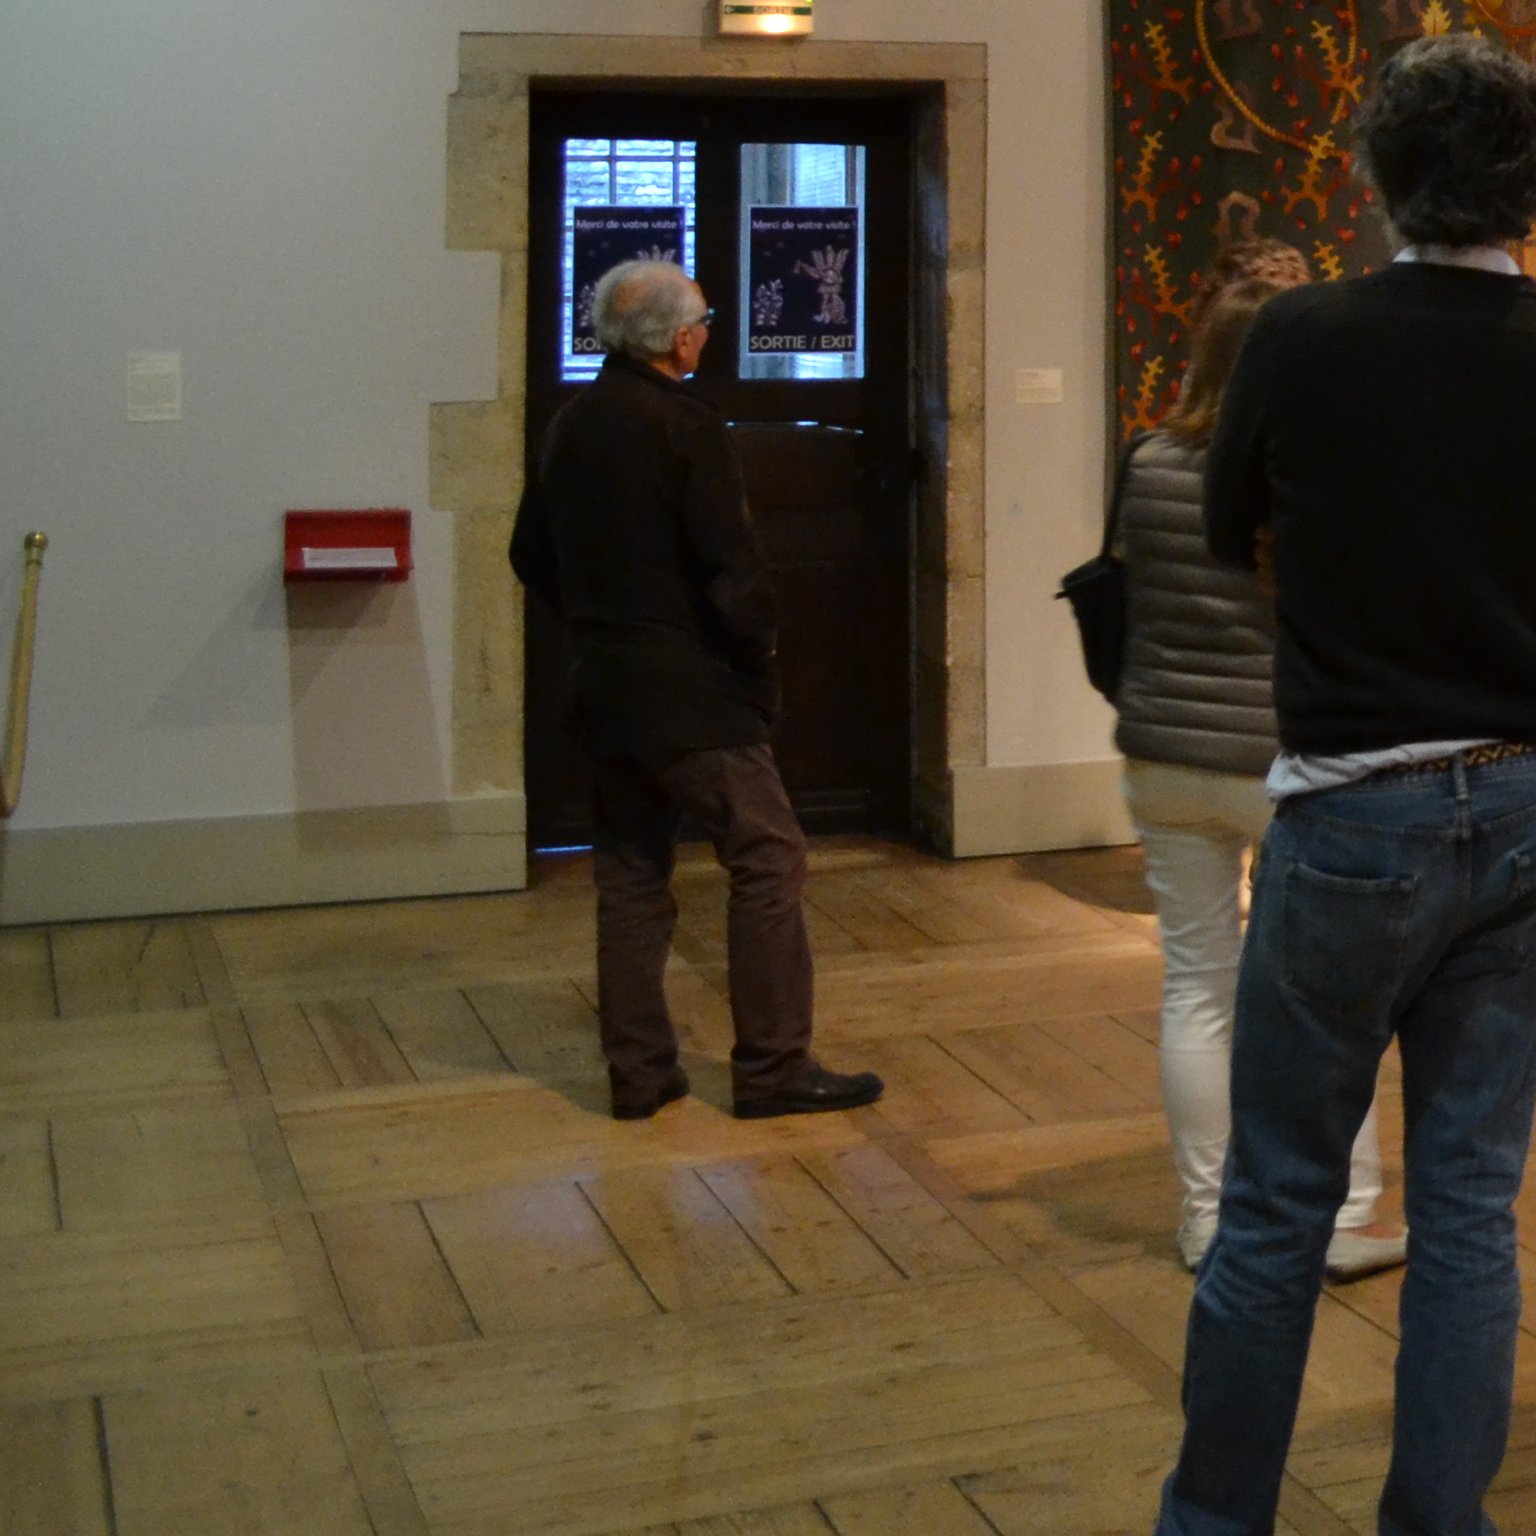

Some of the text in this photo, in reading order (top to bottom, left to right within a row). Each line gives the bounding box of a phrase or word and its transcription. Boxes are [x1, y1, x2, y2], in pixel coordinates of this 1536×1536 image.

[576, 219, 604, 229] Merci
[606, 219, 620, 229] de
[622, 220, 650, 229] votre
[651, 219, 678, 229] visite
[752, 219, 781, 230] Merci
[782, 219, 796, 230] de
[797, 221, 824, 230] votre
[825, 219, 851, 230] visite
[751, 336, 807, 350] SORTIE
[821, 336, 855, 349] EXIT
